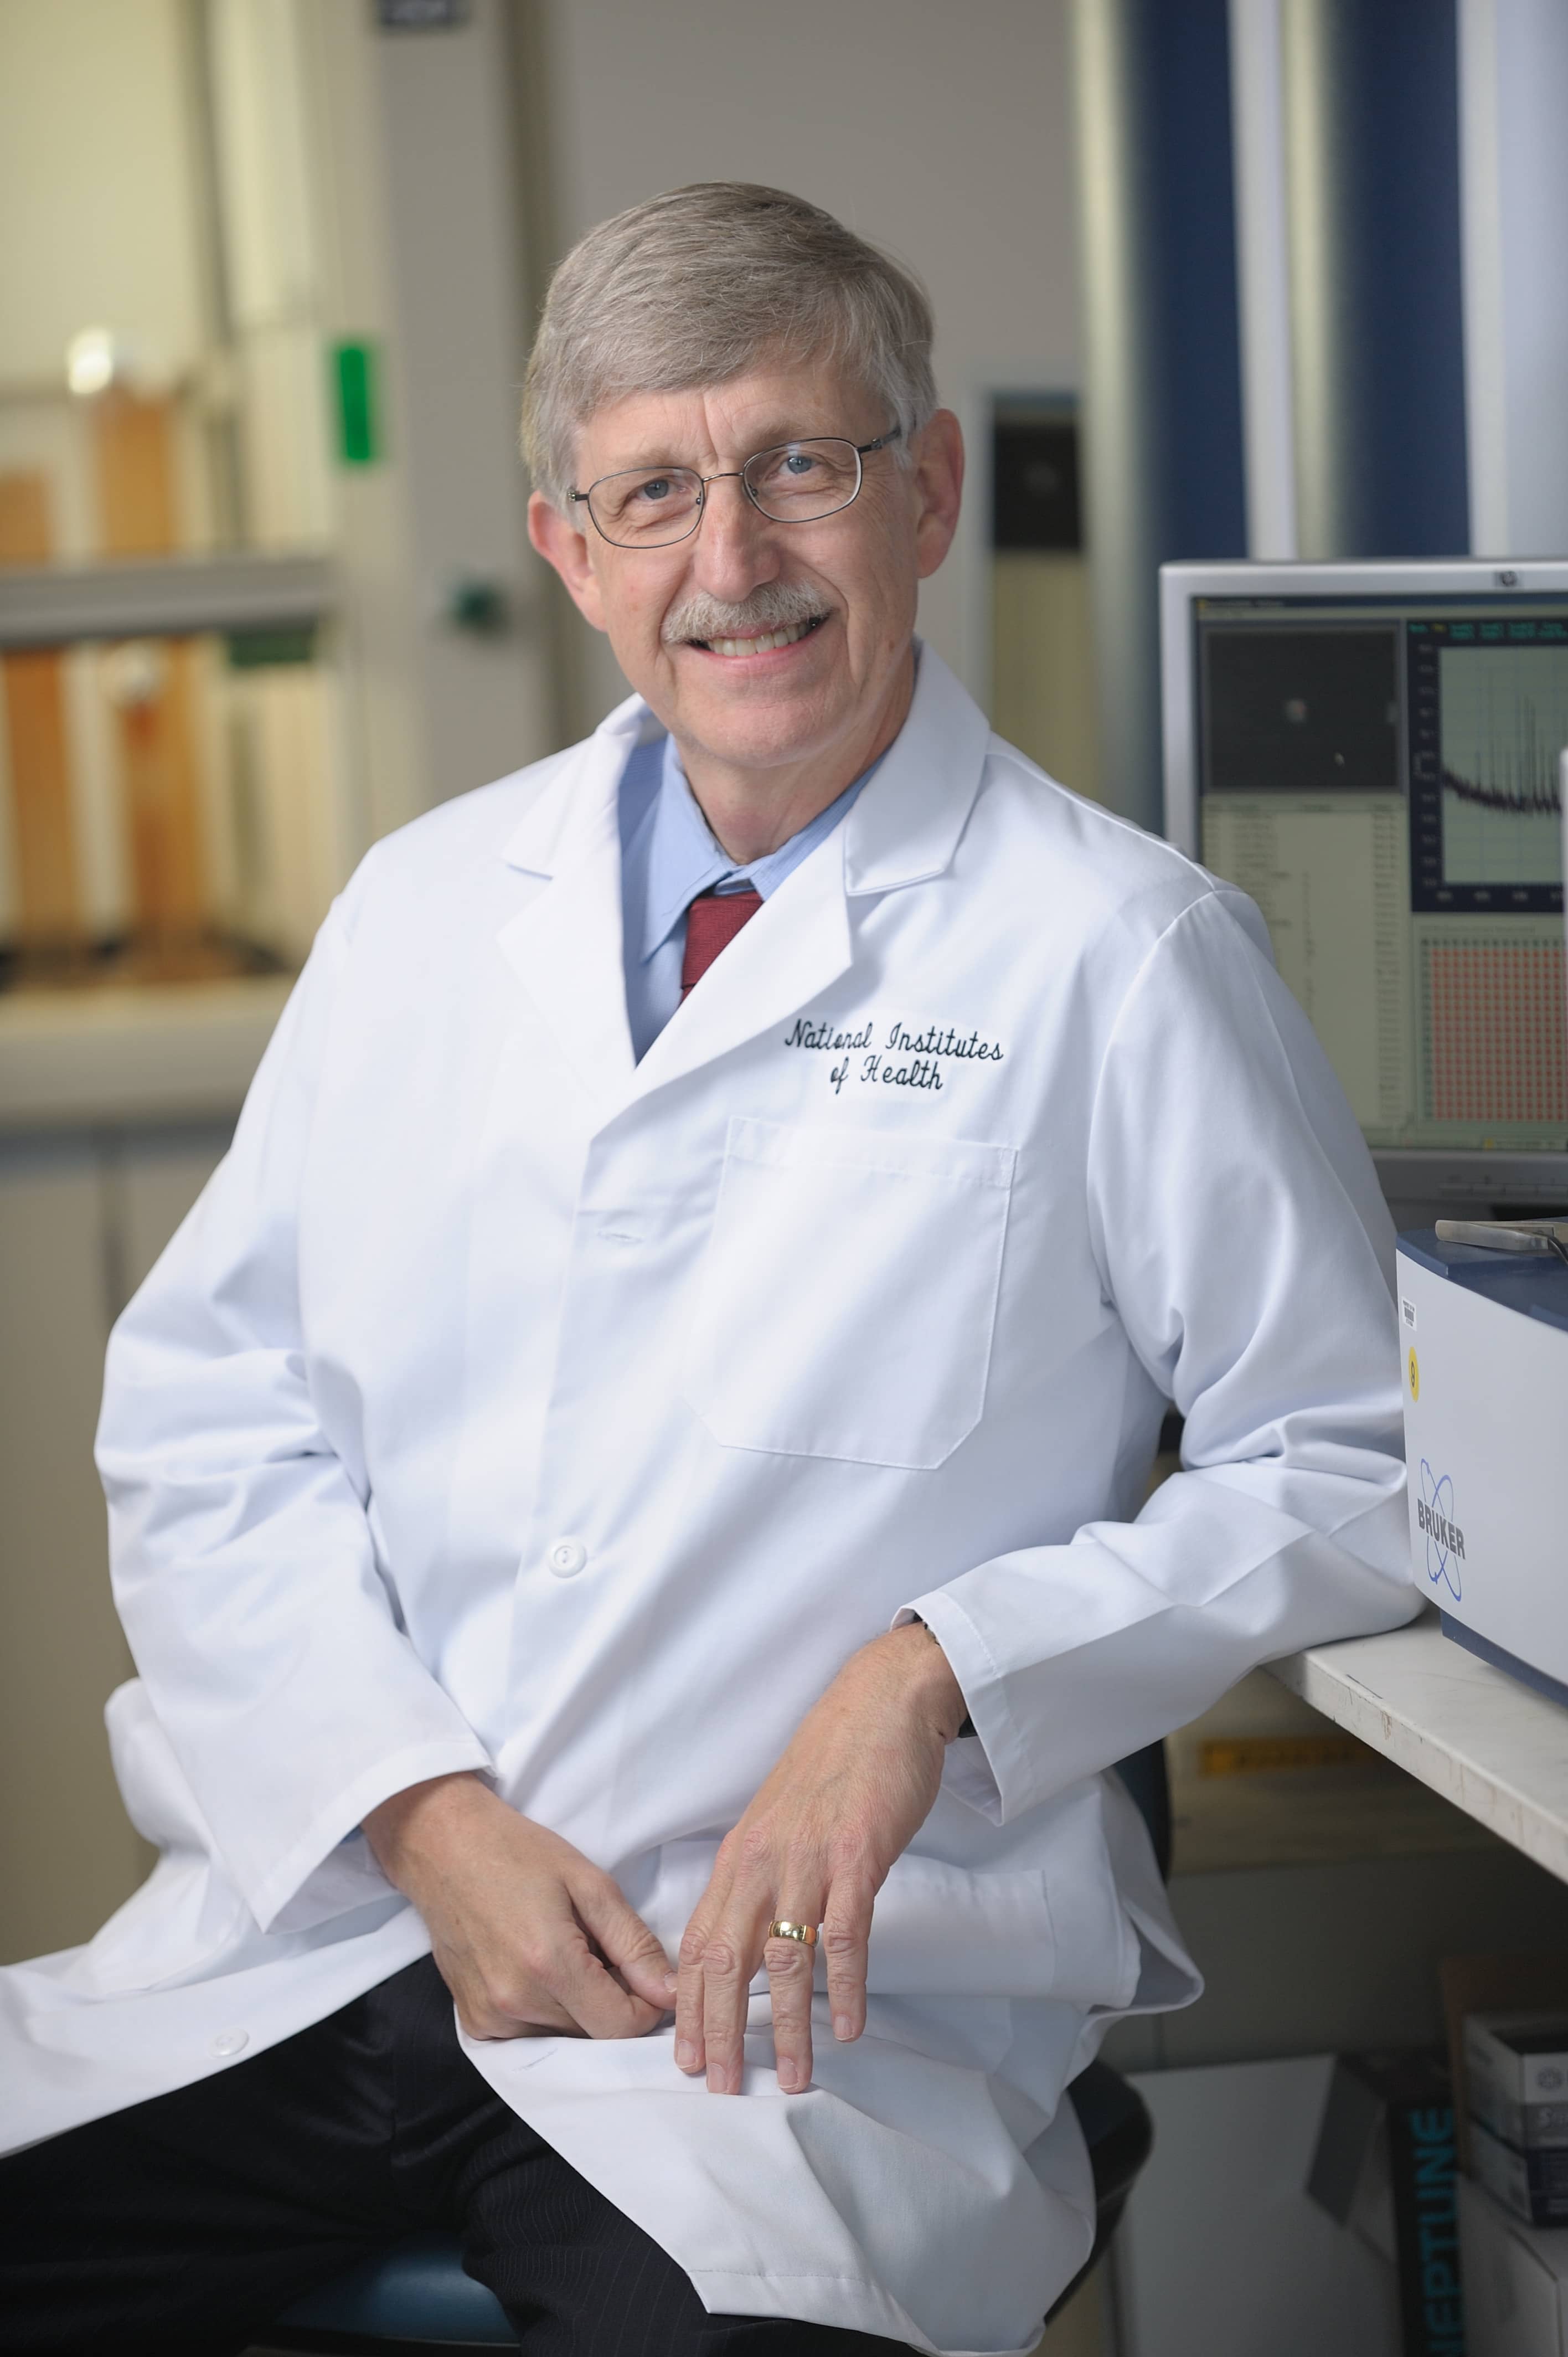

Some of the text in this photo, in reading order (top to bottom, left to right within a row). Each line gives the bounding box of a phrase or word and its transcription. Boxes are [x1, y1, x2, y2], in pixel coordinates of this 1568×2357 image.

[784, 1018, 1004, 1061] National Institutes
[829, 1054, 944, 1095] of Health
[1417, 1497, 1466, 1560] BRUKER
